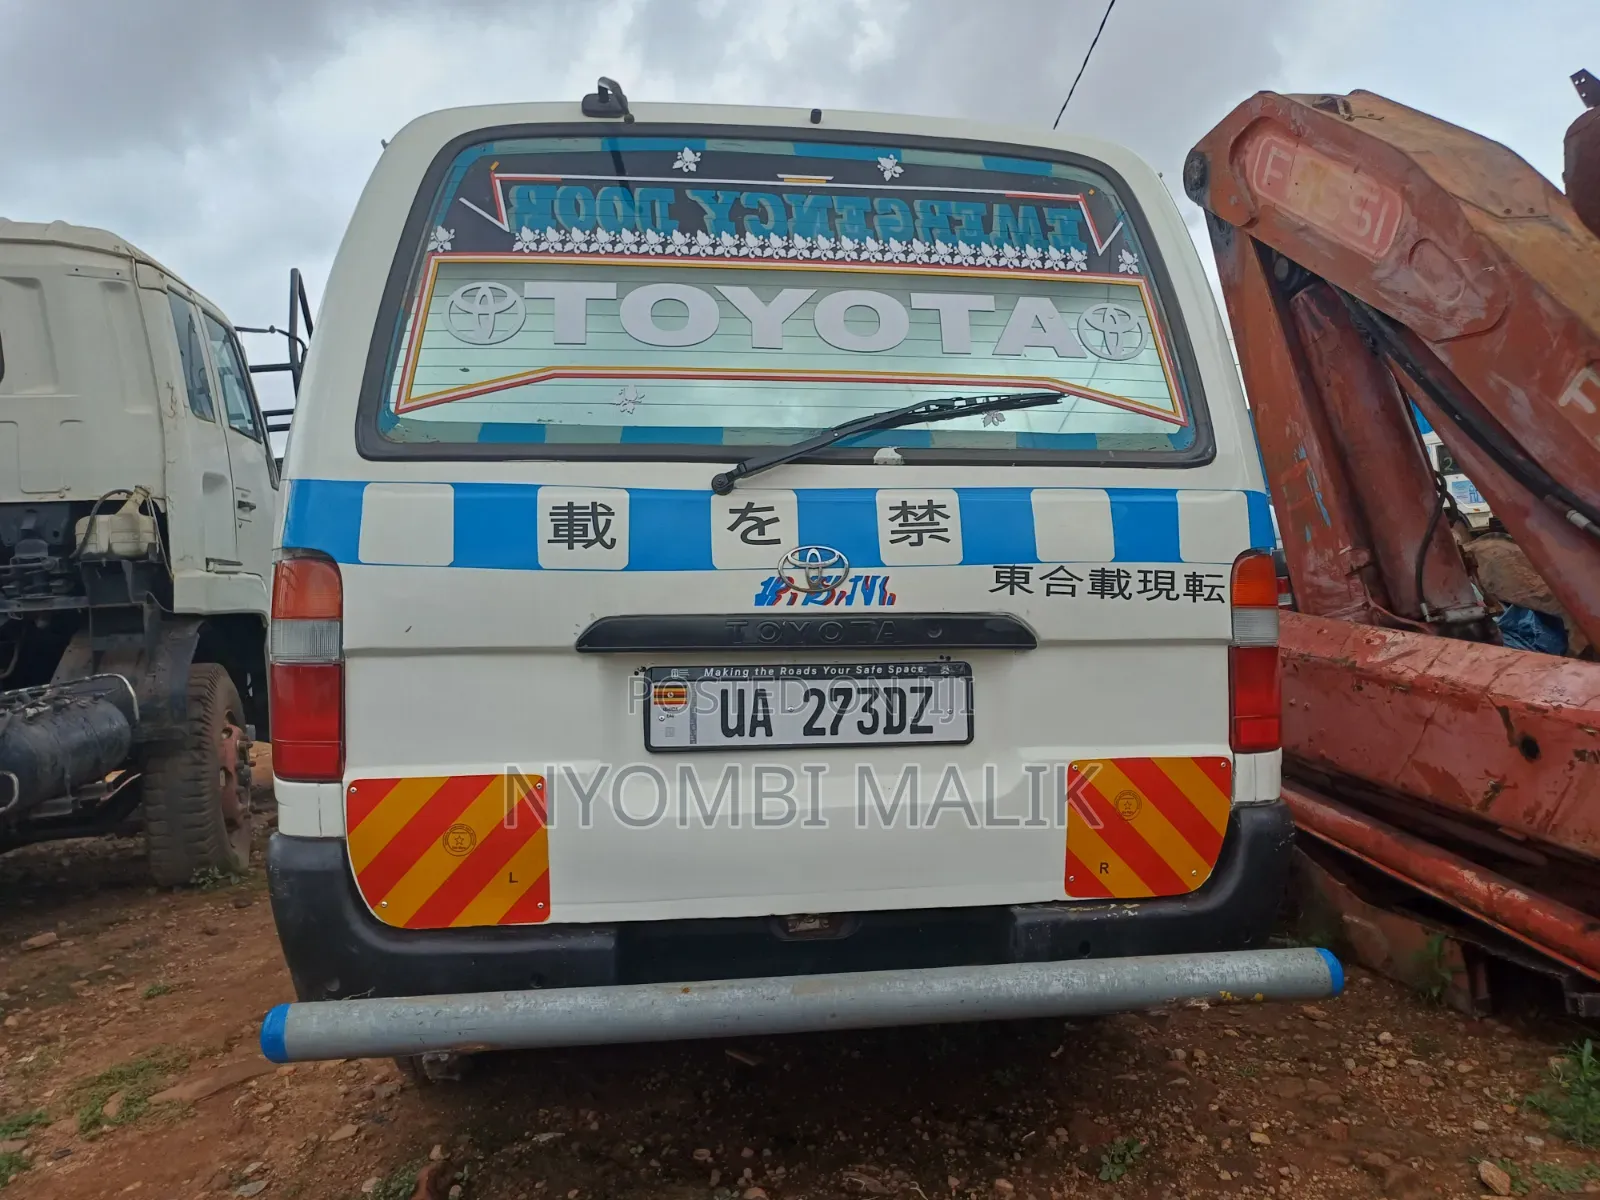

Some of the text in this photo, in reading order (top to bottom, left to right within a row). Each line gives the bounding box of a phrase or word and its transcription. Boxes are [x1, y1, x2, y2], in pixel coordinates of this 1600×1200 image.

[523, 281, 1088, 359] TOYOTA
[547, 499, 951, 550] 載 を 禁
[725, 620, 905, 645] TOYOTA
[703, 665, 925, 678] Making the Roads Your Safe Space
[720, 688, 774, 738] UA
[803, 686, 934, 737] 273DZ
[508, 871, 519, 884] L
[1099, 861, 1110, 875] R
